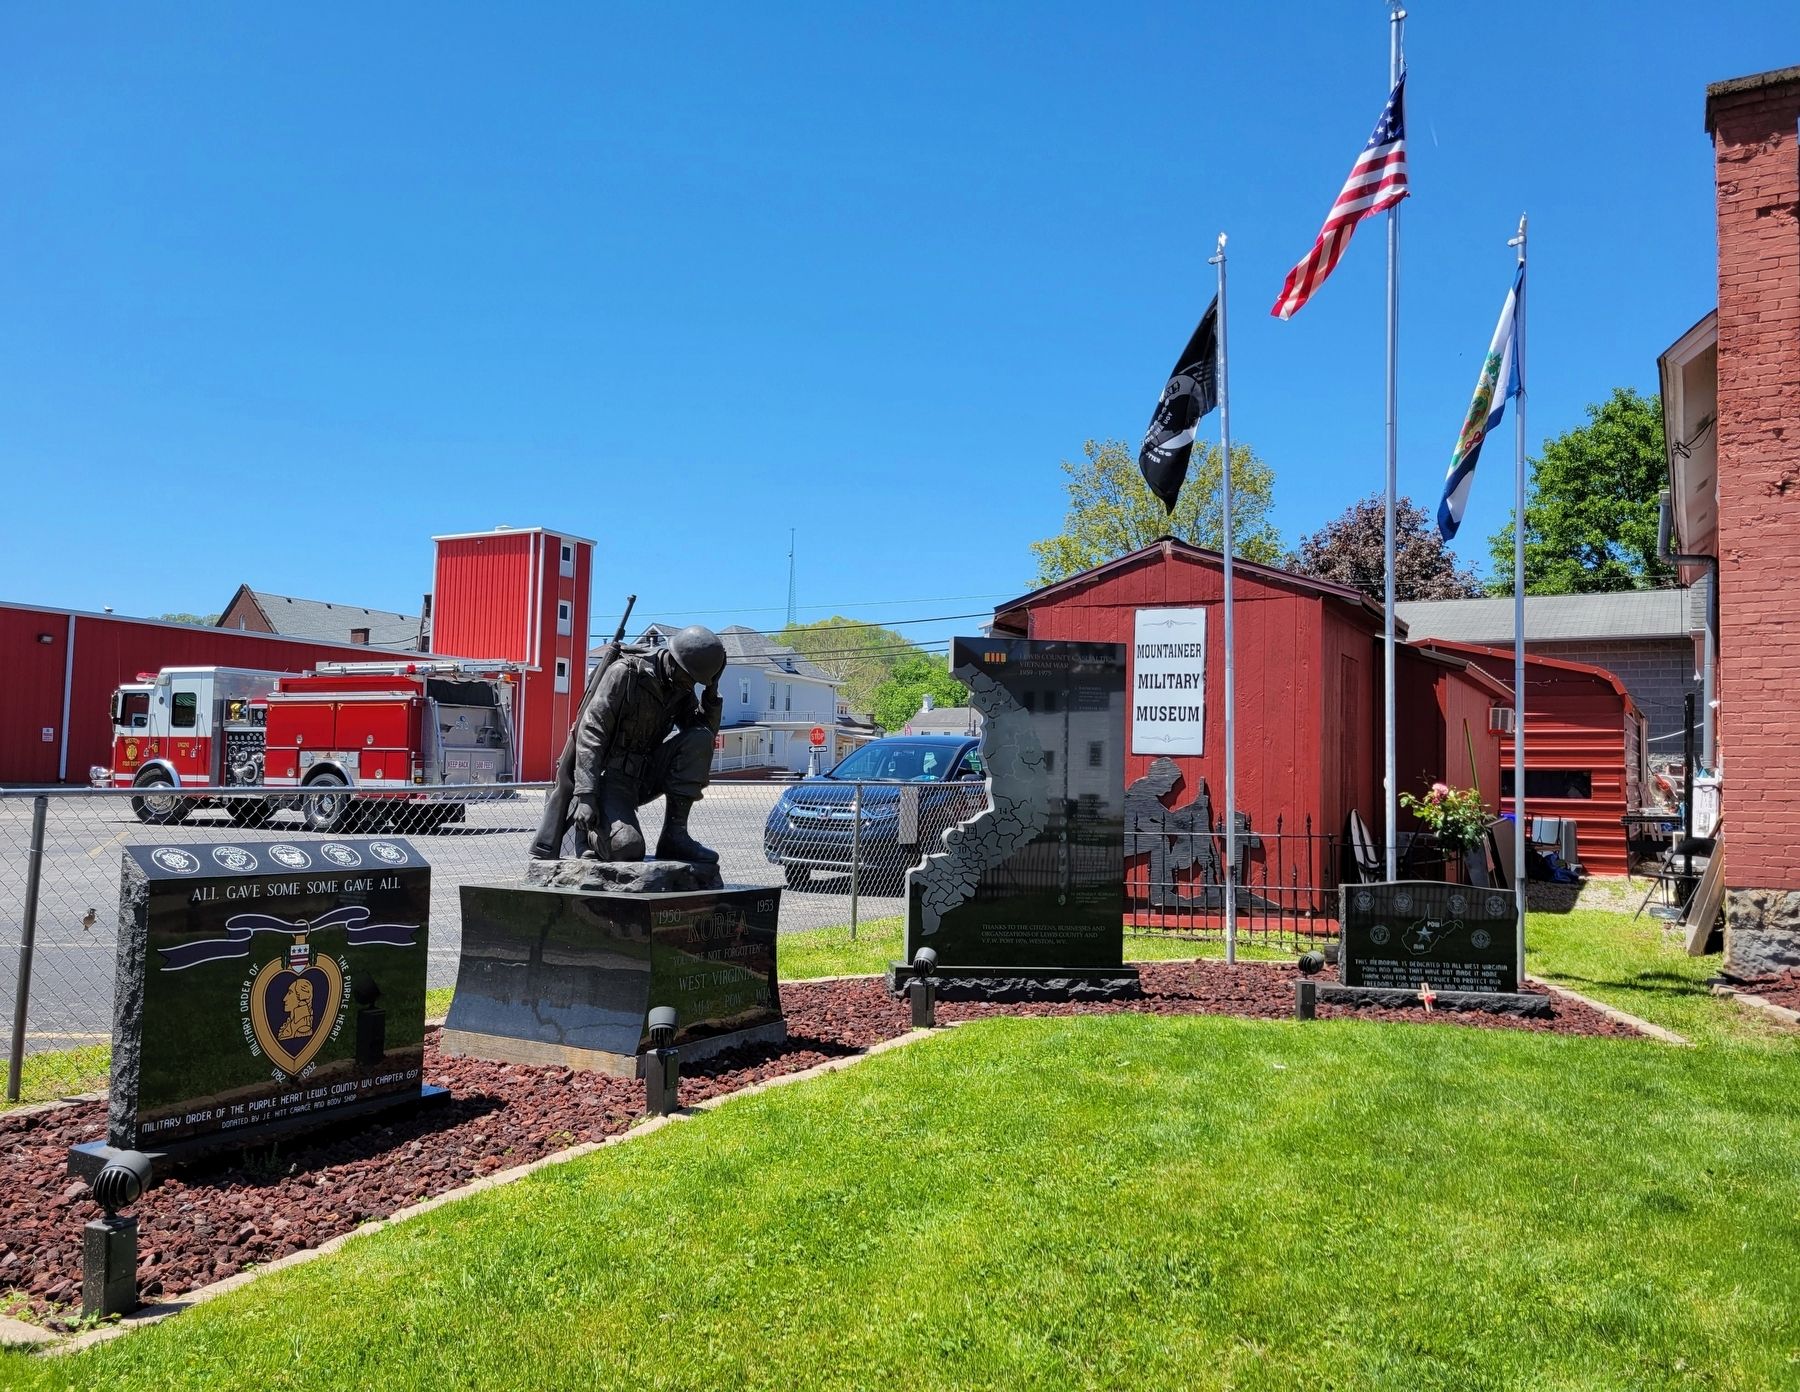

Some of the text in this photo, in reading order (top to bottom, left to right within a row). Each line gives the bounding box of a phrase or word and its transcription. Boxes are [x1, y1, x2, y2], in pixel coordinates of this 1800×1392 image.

[1137, 643, 1202, 658] MOUNTAINEER
[1138, 673, 1200, 690] MILITARY
[1136, 706, 1200, 722] MUSEUM
[810, 732, 824, 741] STOP
[192, 876, 401, 902] ALL GAVE SOME SOME GAVE ALL
[757, 899, 774, 912] 1953
[659, 908, 681, 924] 1950
[687, 910, 750, 942] KOREA
[708, 949, 722, 960] NOT
[679, 965, 754, 992] WEST VIRGINIA
[329, 954, 352, 1042] THE PURPLE HEART
[240, 962, 262, 1057] MILITARY ORDER OF
[270, 1068, 287, 1084] 1782
[300, 1061, 318, 1079] 1932
[141, 1069, 419, 1134] MILITARY ORDER OF THE PURPLE HEART LEWIS COUNTY WV CHAPTER 697
[222, 1116, 249, 1129] DONATED
[251, 1114, 260, 1123] BY
[290, 1103, 311, 1114] GARAGE
[314, 1100, 324, 1109] AND
[327, 1098, 341, 1107] BODY
[344, 1094, 357, 1104] SHOP
